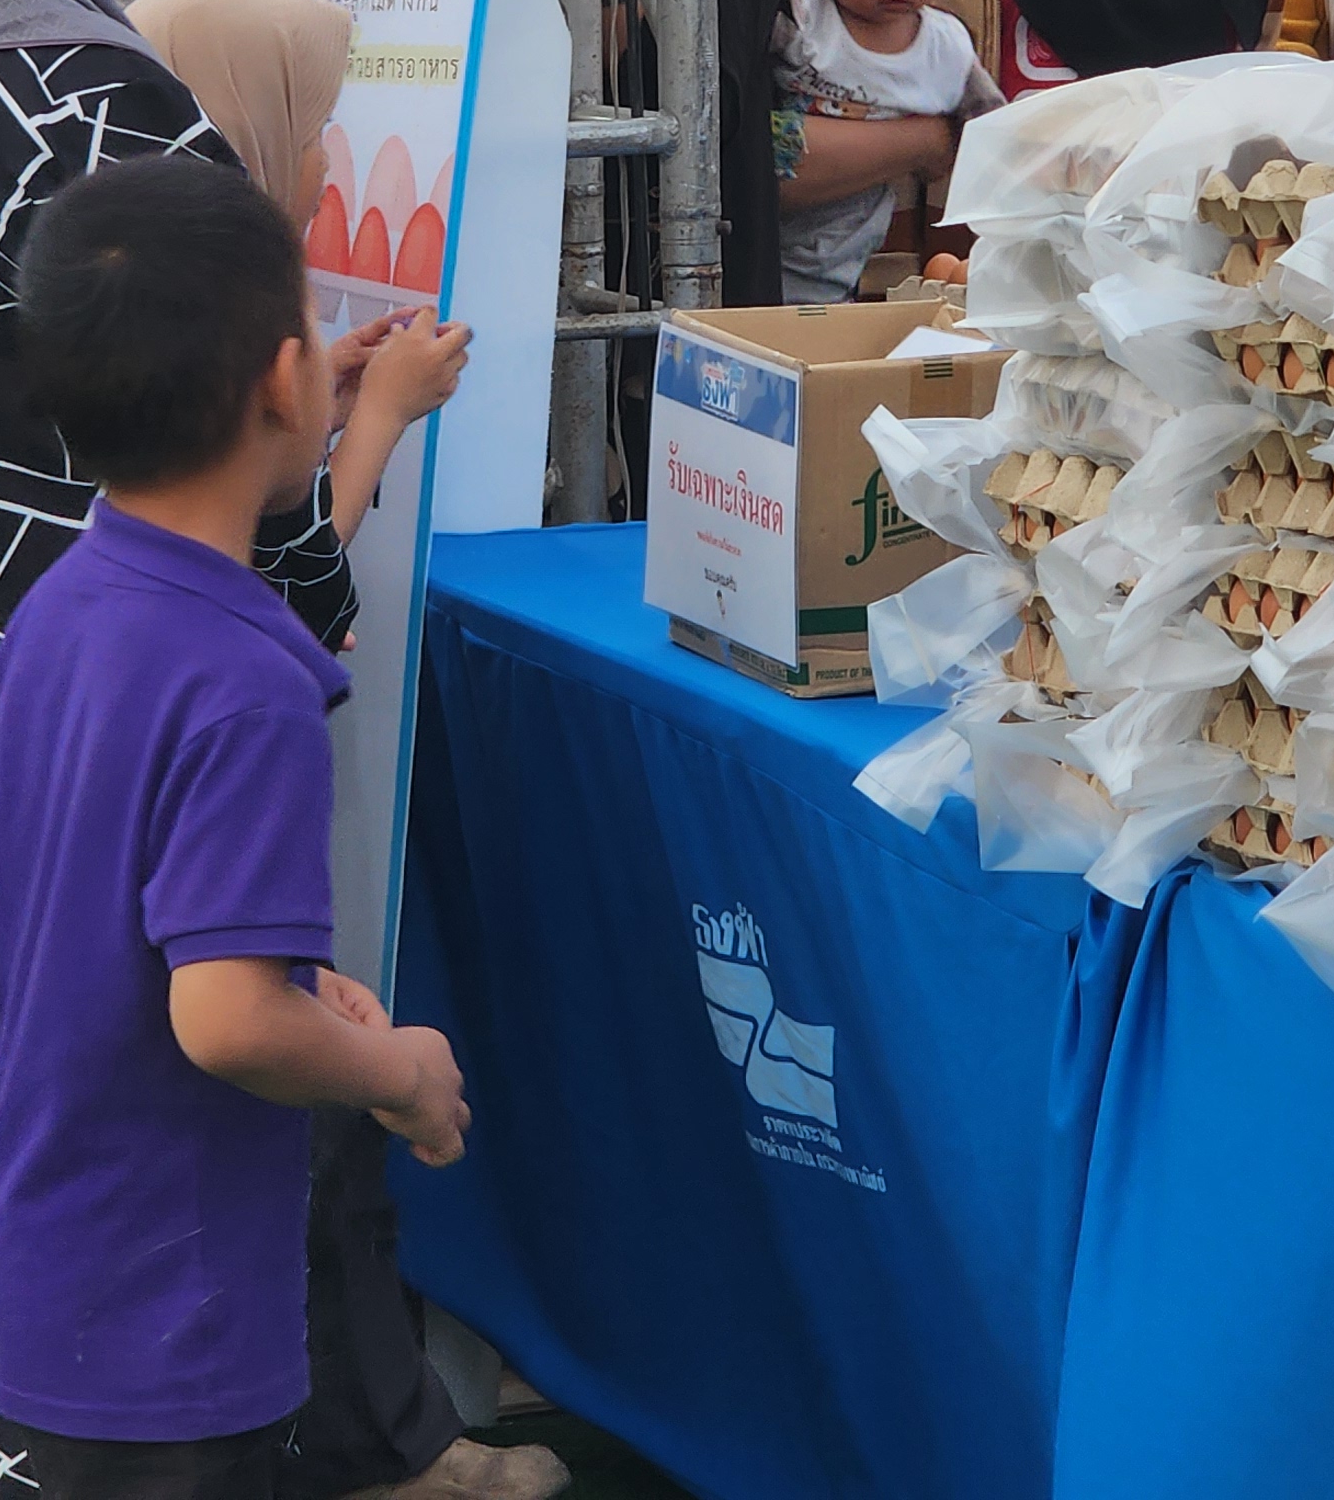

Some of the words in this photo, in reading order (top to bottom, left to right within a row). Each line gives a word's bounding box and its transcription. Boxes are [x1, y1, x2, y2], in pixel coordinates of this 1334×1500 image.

[667, 440, 784, 535] รับเฉพาะเงินสด
